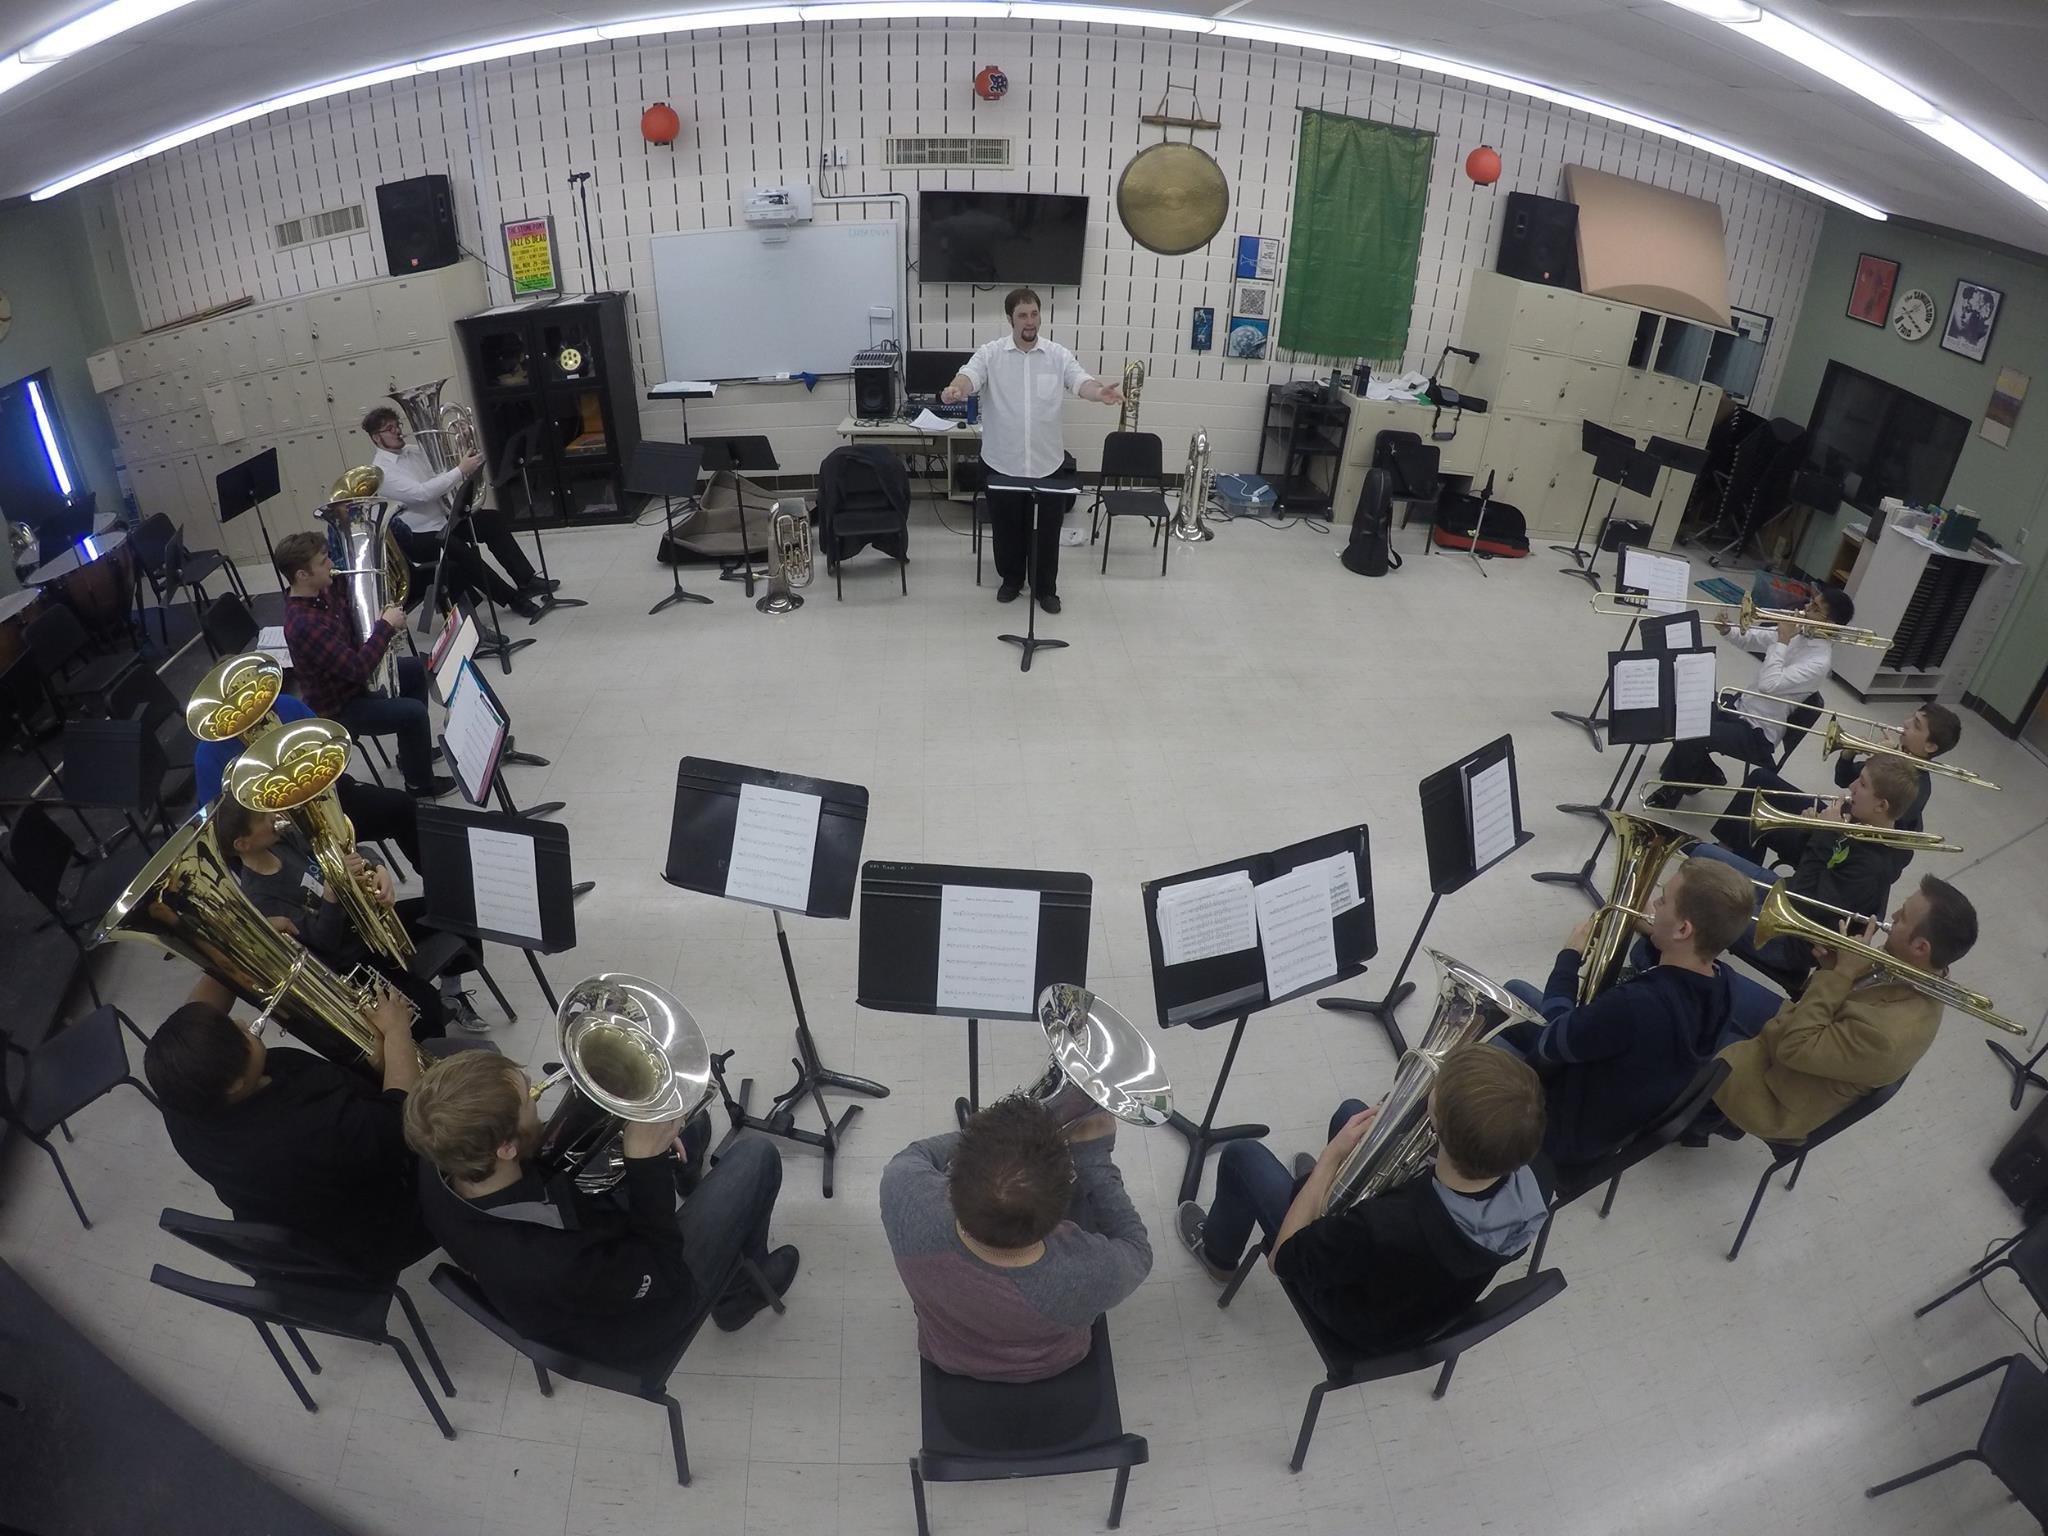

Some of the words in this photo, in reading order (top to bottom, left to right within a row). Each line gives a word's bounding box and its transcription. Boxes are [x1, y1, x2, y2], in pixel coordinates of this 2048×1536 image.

[510, 238, 523, 247] JAZZ
[524, 235, 531, 245] IS
[532, 233, 547, 243] DEAD
